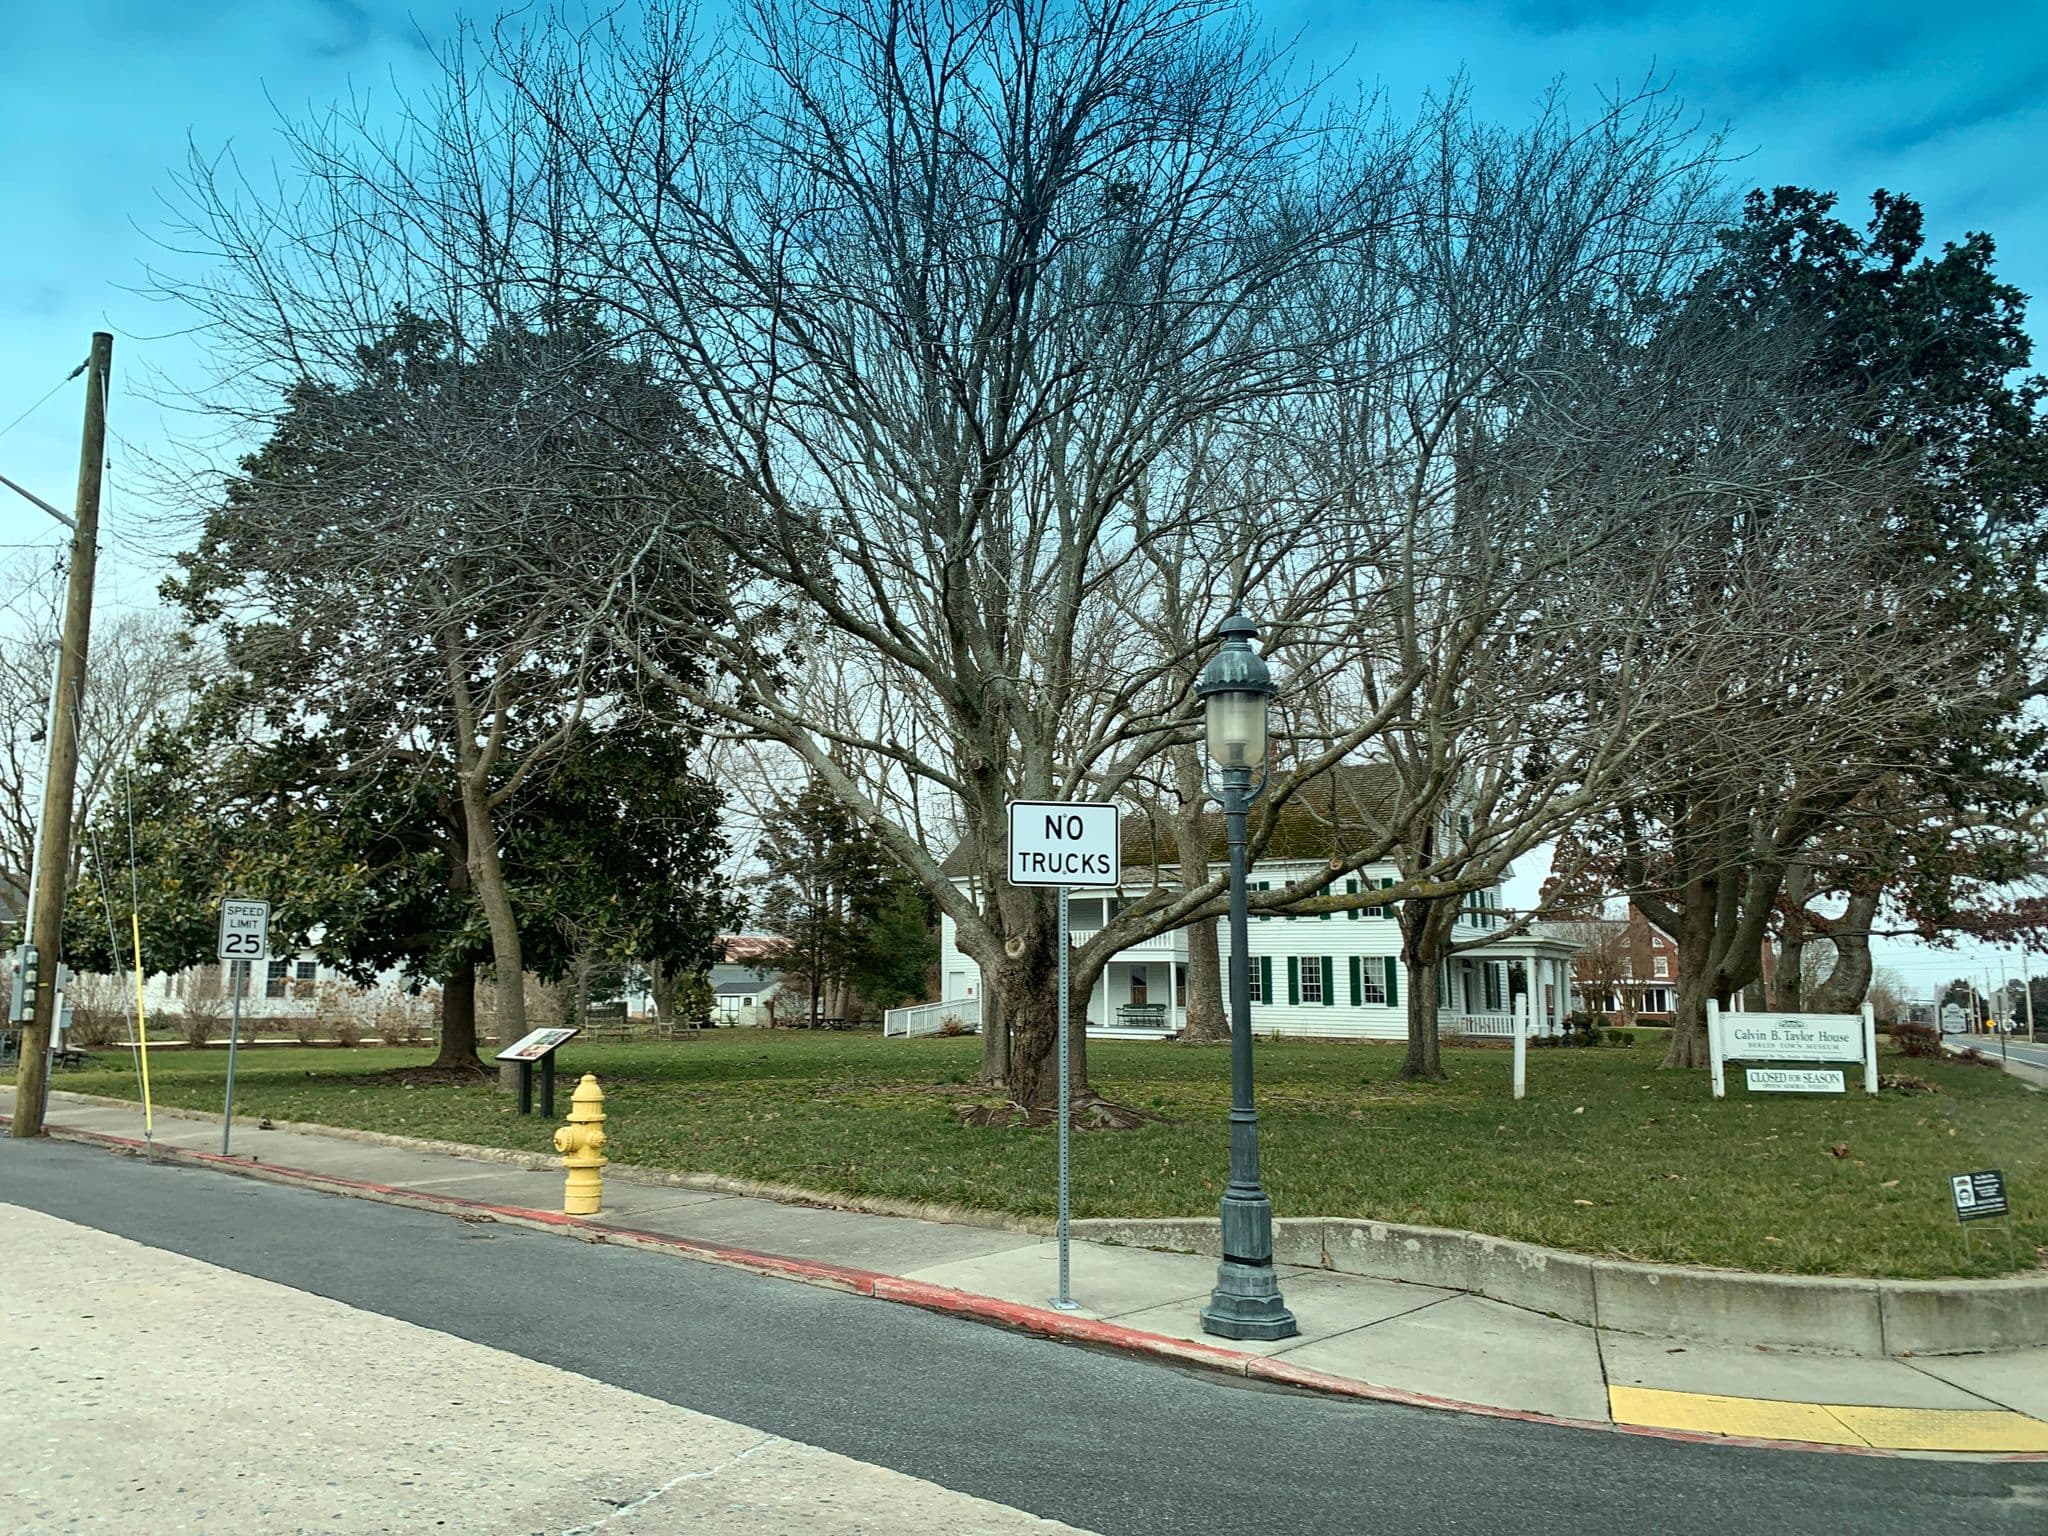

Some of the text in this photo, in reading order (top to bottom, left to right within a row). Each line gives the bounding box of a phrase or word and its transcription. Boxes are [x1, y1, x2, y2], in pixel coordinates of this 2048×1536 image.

[1045, 814, 1084, 841] NO
[1018, 852, 1110, 874] TRUCKS
[227, 906, 264, 916] SPEED
[230, 919, 258, 928] LIMIT
[225, 933, 260, 954] 25
[1734, 1029, 1850, 1044] Calvin B. Taylor House
[1750, 1072, 1787, 1083] CLOSED
[1803, 1073, 1840, 1084] SEASON
